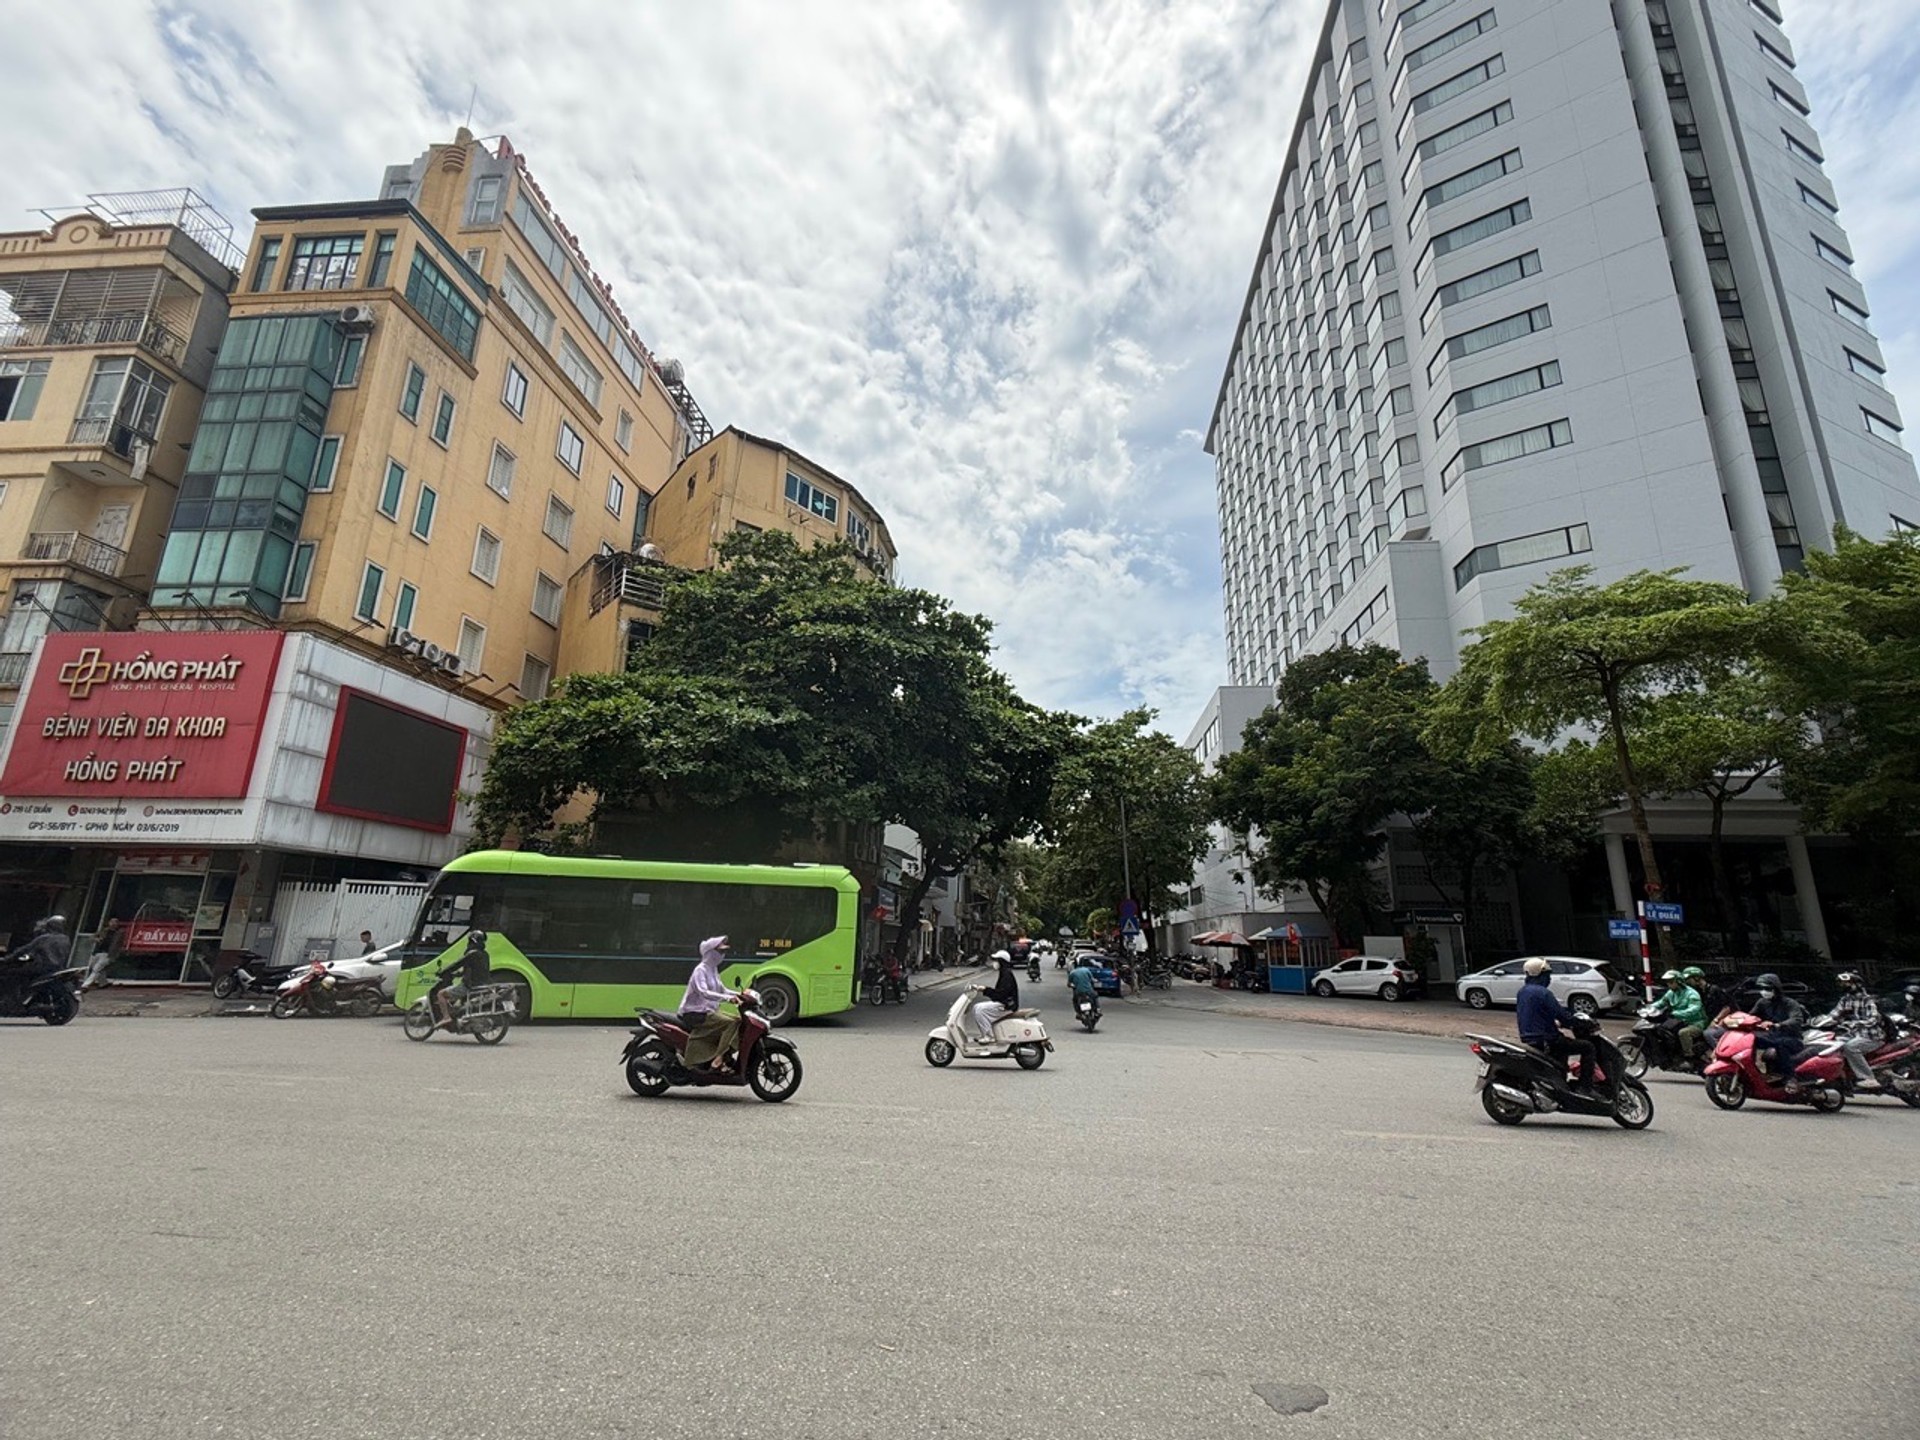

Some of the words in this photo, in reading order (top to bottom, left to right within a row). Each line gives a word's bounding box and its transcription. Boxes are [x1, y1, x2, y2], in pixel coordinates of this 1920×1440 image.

[112, 650, 178, 681] HỒNG
[181, 653, 242, 680] PHÁT
[160, 683, 194, 691] GENERAL
[198, 683, 236, 691] HOSPITAL
[42, 712, 91, 741] BỆNH
[97, 711, 139, 742] VIỆN
[144, 716, 170, 737] ĐA
[174, 716, 227, 737] KHOA
[63, 751, 119, 781] HỒNG
[125, 755, 183, 781] PHÁT
[136, 823, 180, 832] 03/6/2019
